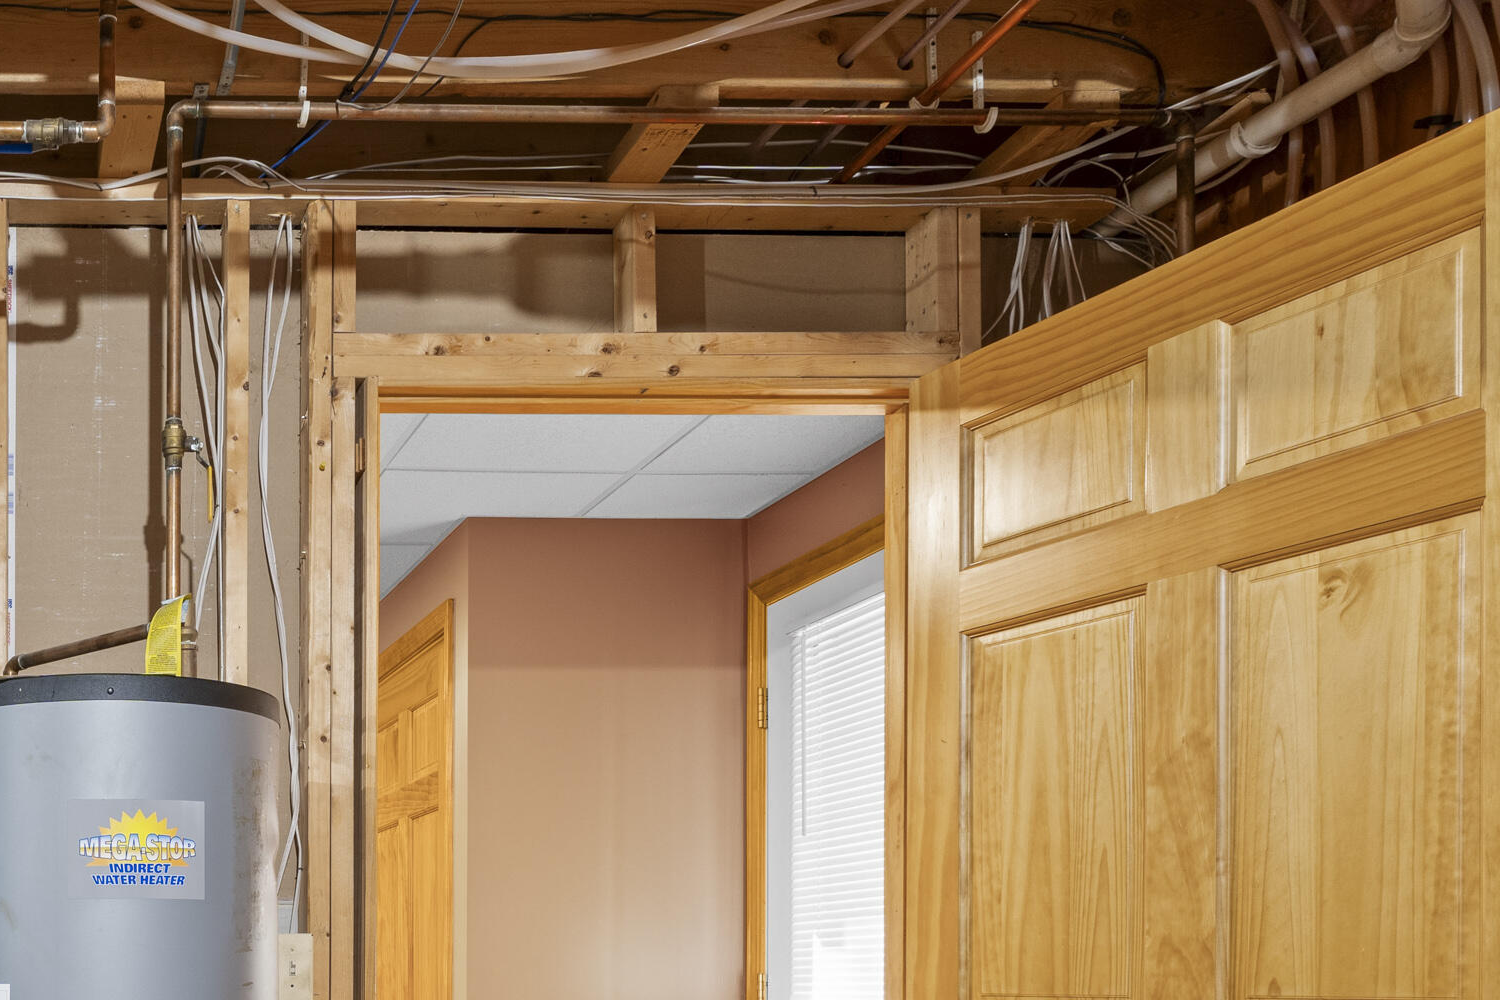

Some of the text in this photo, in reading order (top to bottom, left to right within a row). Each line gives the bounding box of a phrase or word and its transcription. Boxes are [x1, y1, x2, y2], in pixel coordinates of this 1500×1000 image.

[109, 863, 171, 874] INDIRECT
[92, 875, 185, 886] WATER HEATER
